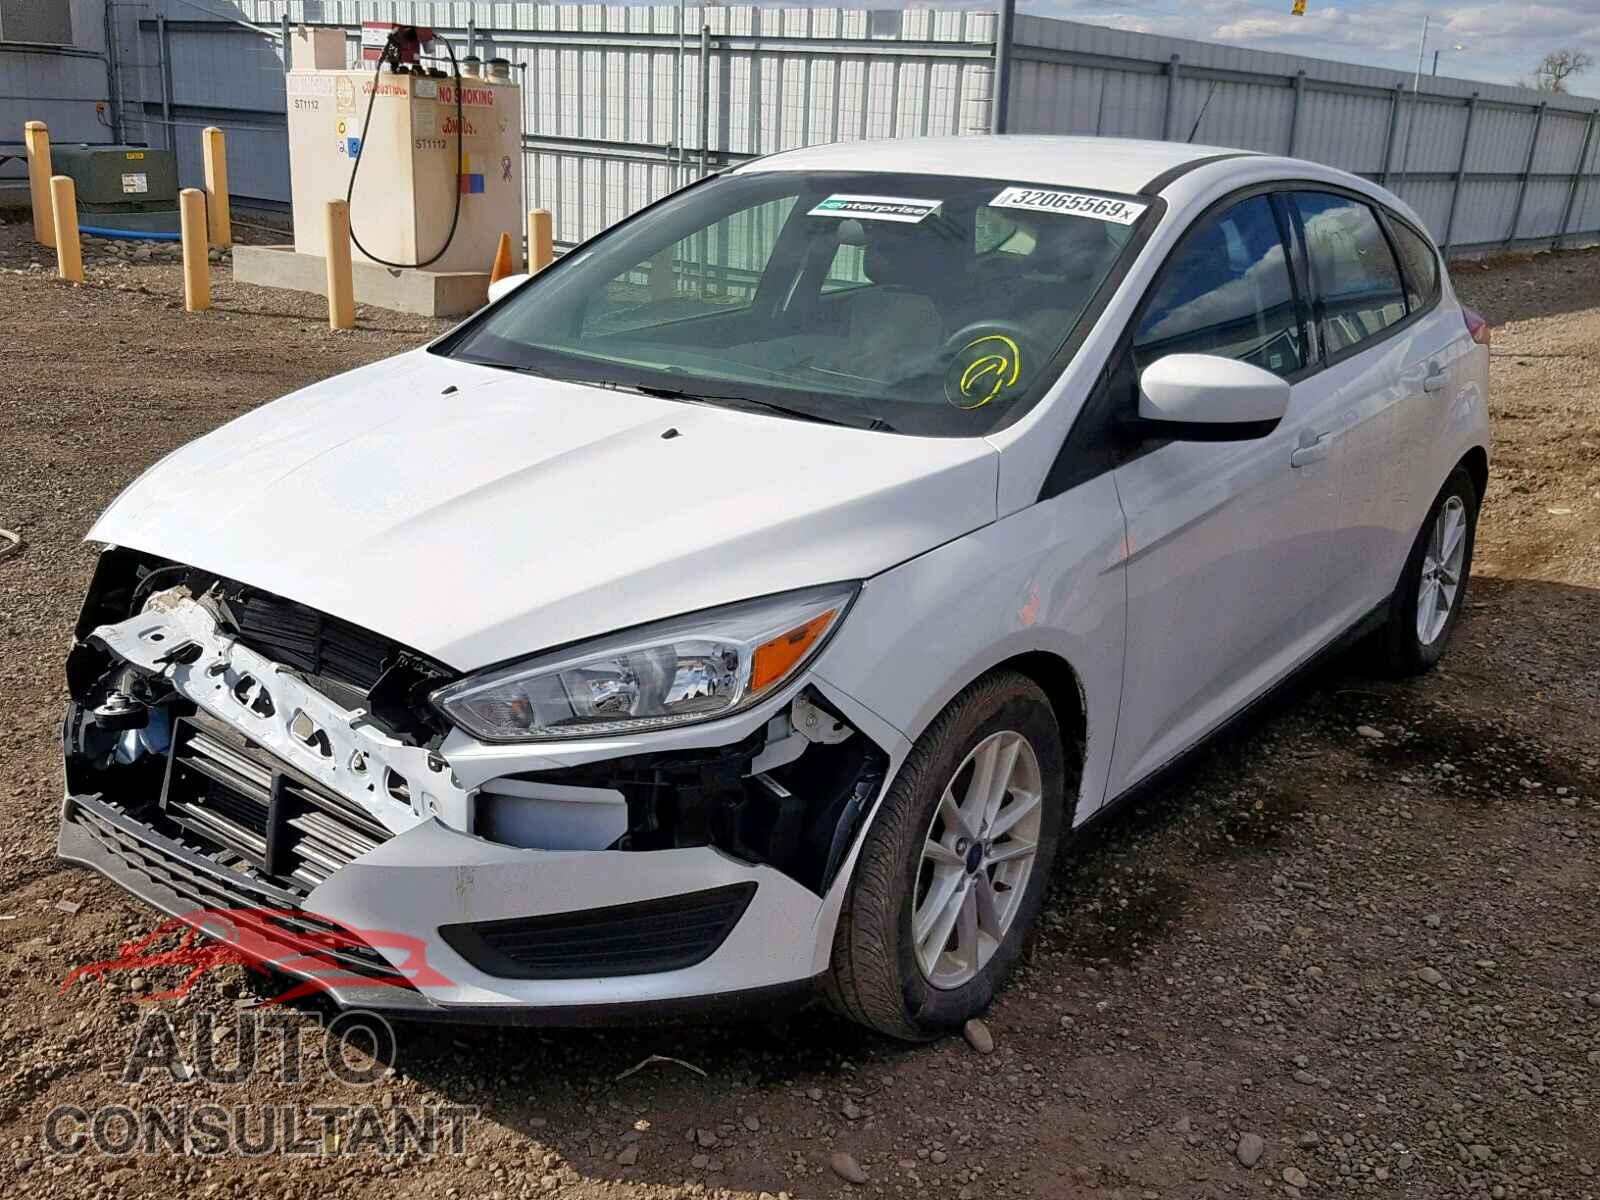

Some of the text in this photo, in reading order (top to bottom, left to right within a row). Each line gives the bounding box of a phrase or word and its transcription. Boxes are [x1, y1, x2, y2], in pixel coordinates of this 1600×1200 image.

[439, 87, 451, 103] NO
[294, 99, 319, 110] ST1112
[415, 139, 447, 150] ST1112
[822, 201, 929, 216] enterprise
